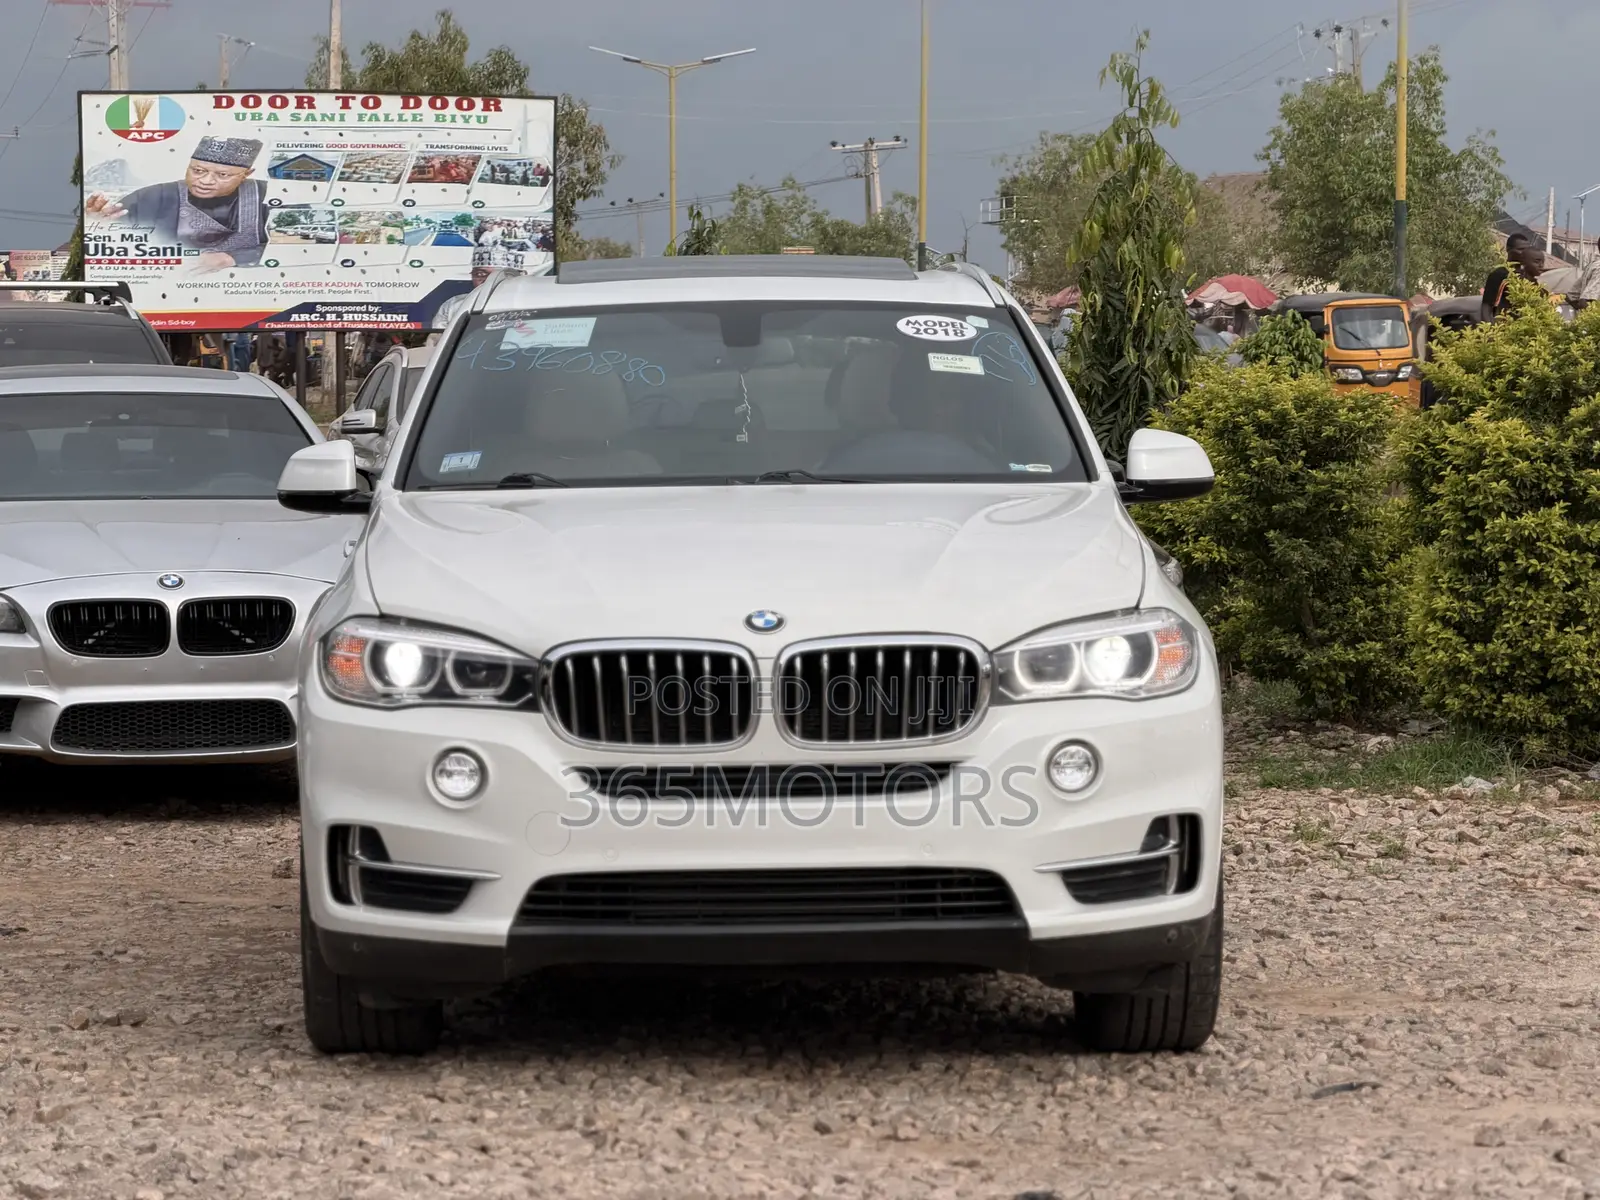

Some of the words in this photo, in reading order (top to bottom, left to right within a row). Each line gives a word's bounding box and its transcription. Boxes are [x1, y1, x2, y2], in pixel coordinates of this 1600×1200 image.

[213, 95, 316, 110] DOOR
[335, 96, 382, 110] TO
[400, 96, 502, 112] DOOR
[234, 112, 280, 122] UBA
[290, 112, 346, 122] SANI
[357, 113, 424, 122] FALLE
[434, 114, 488, 124] BIYU
[128, 132, 164, 140] APC
[84, 232, 116, 242] Sen.
[120, 234, 148, 242] Mal
[84, 243, 128, 256] Uba
[134, 243, 182, 257] Sani
[316, 304, 366, 313] Sponspored
[290, 313, 324, 321] ARC.
[905, 319, 968, 330] MODEL
[911, 326, 966, 337] 2018
